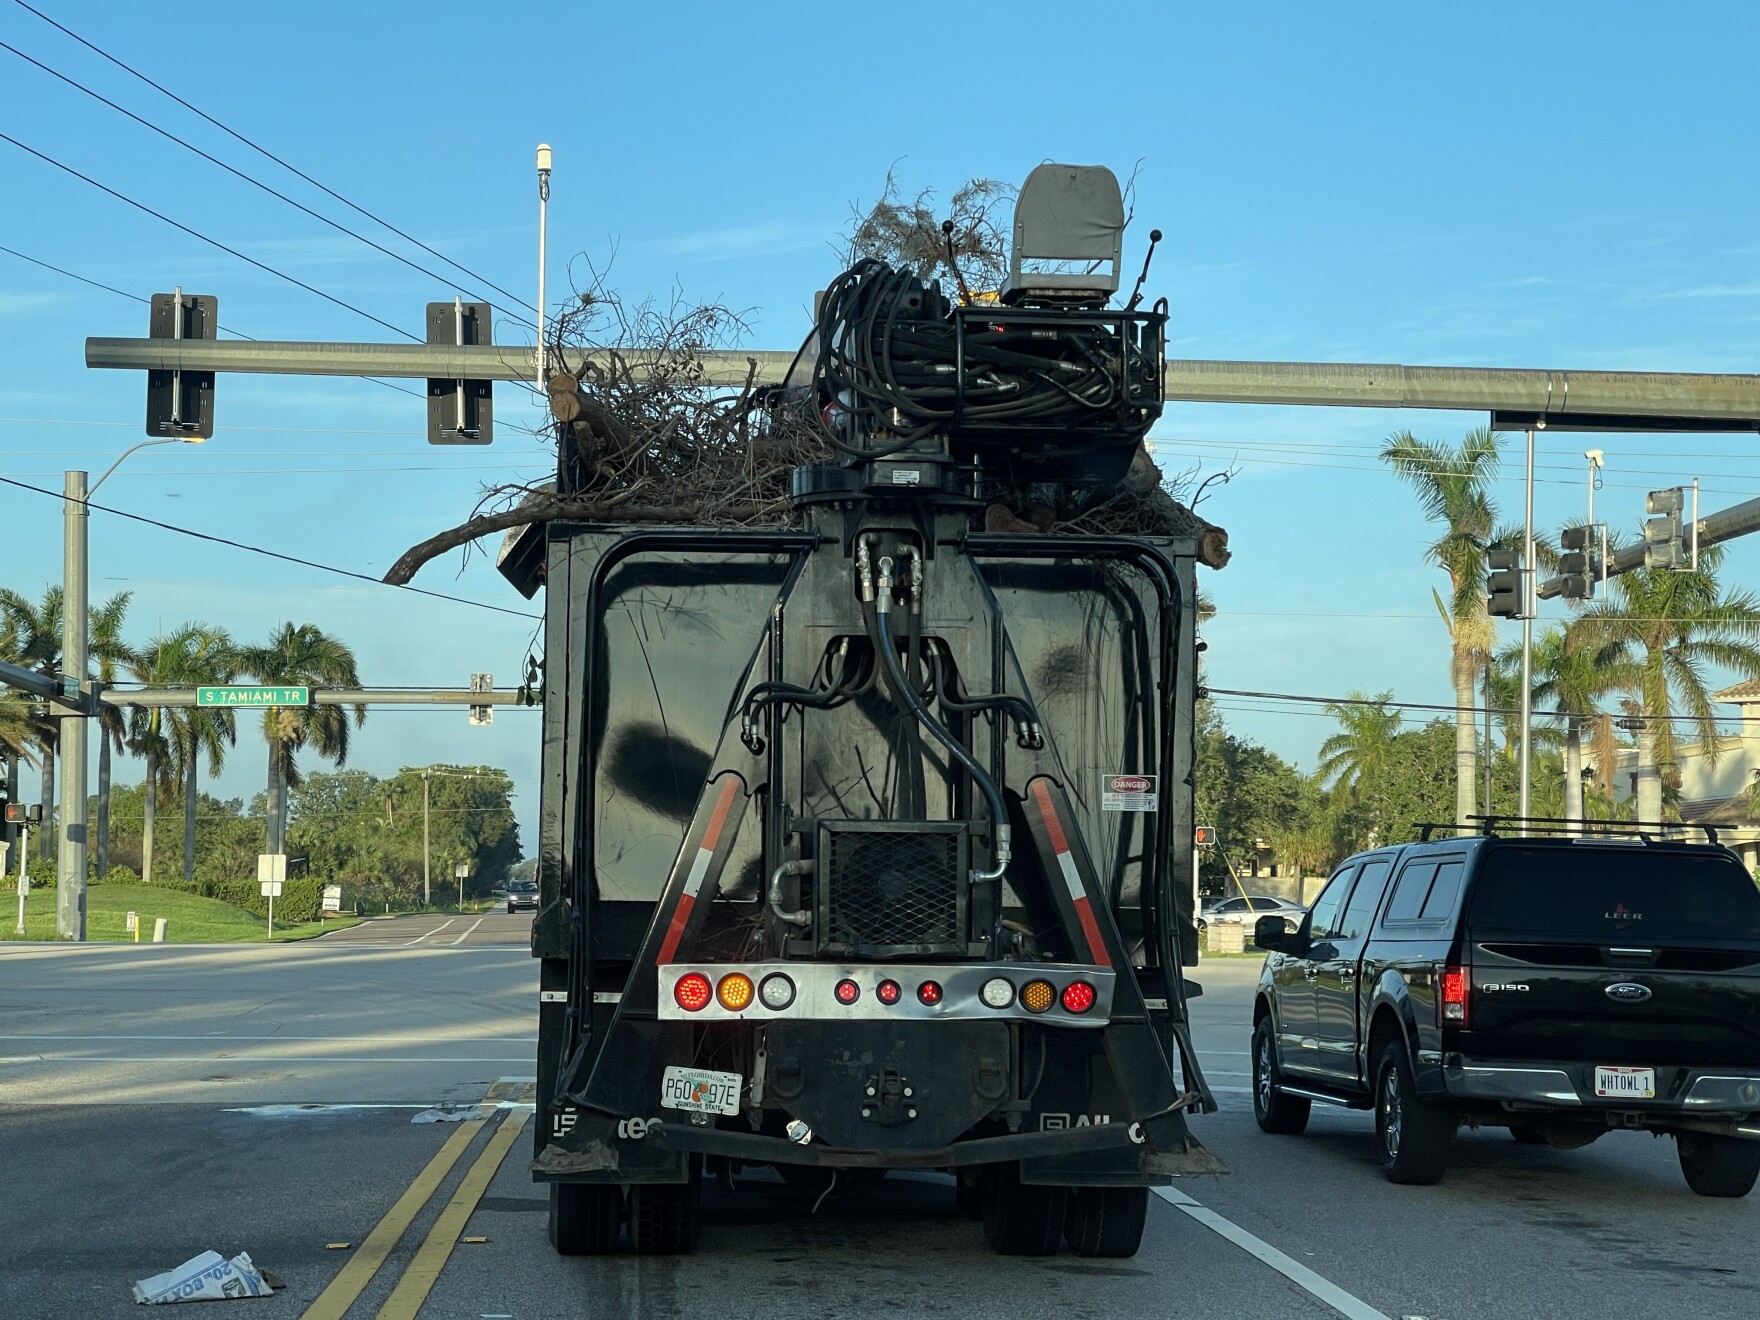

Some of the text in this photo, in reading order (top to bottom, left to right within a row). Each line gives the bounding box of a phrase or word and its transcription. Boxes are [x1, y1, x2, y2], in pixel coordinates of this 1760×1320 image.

[206, 691, 300, 702] S TAMIAMI TR
[1114, 781, 1147, 789] DANGER
[1604, 912, 1642, 920] LEER
[1617, 986, 1641, 998] Ford
[1601, 1074, 1650, 1091] WHTOWL 1
[677, 1101, 721, 1112] SUNSHINE STATE
